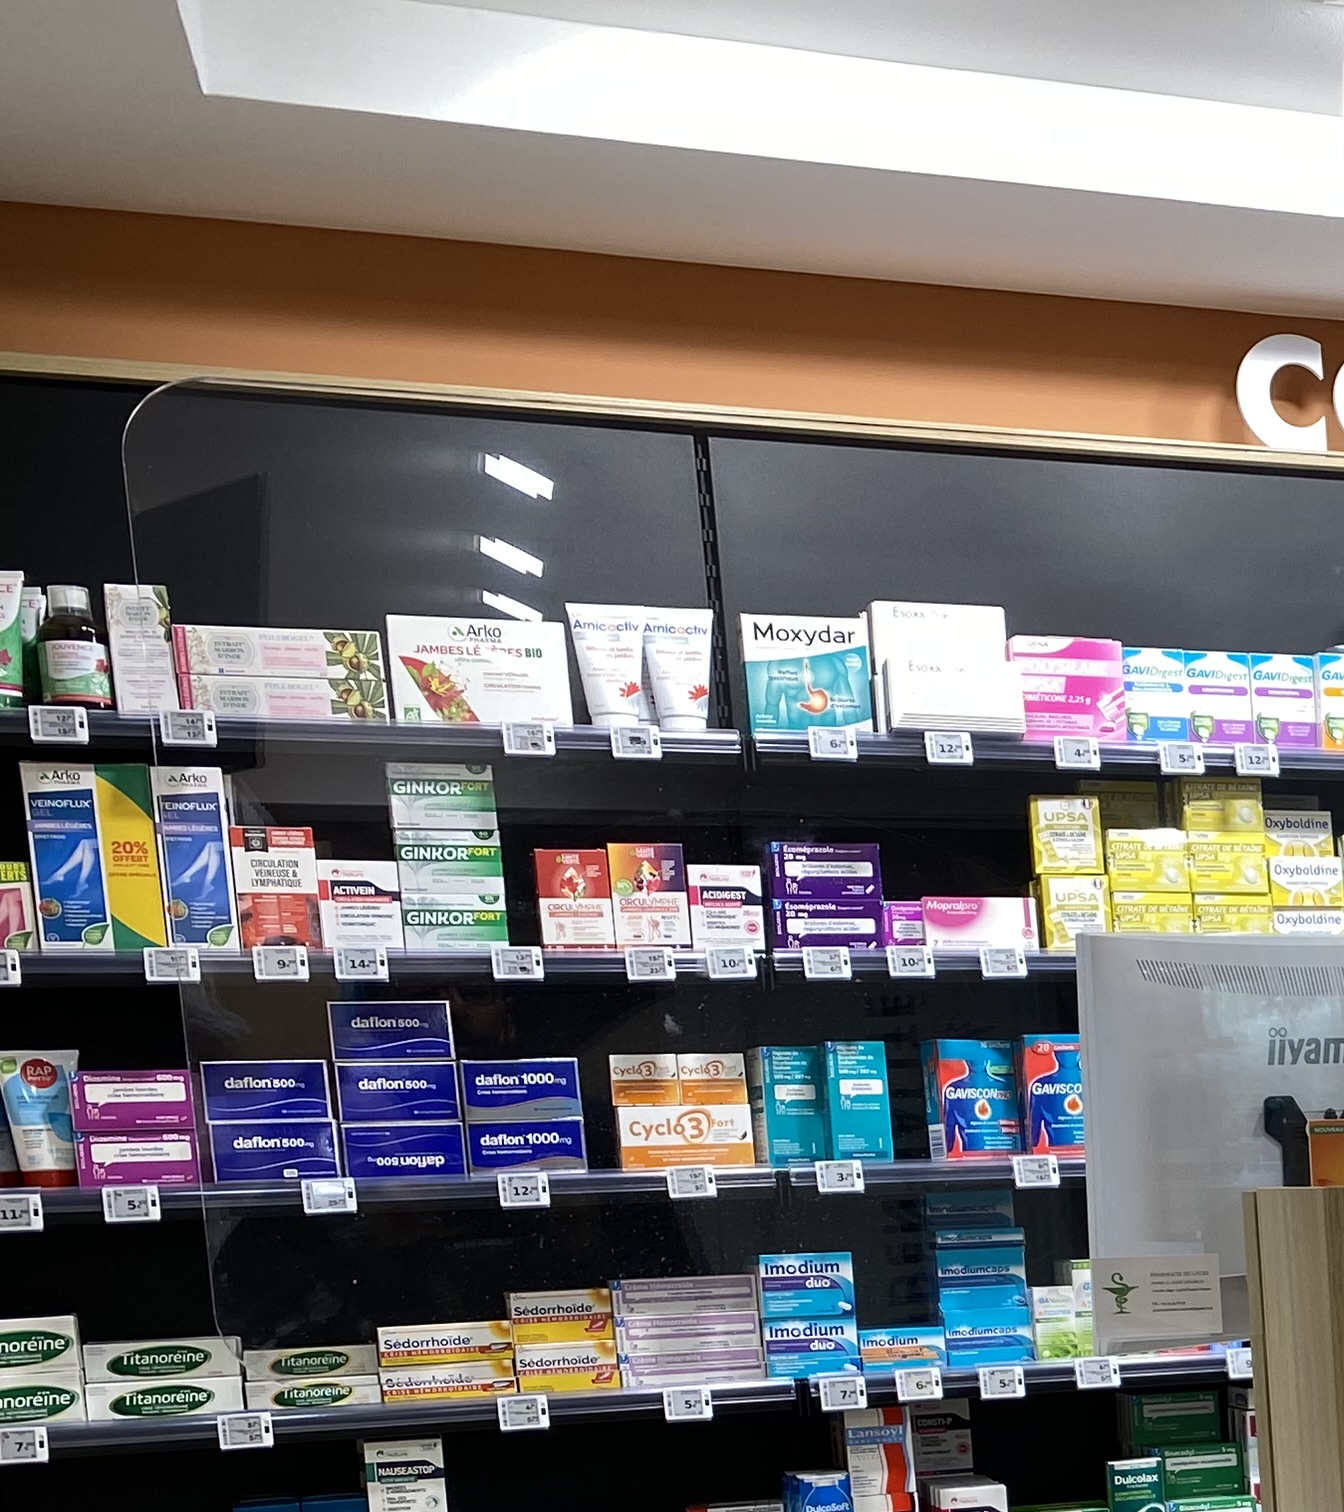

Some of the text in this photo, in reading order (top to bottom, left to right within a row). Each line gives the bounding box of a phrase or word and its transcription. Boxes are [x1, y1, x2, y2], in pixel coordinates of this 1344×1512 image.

[466, 625, 501, 638] Arko
[753, 621, 856, 646] Moxydar
[414, 645, 542, 658] JAMBES BIO
[31, 799, 91, 811] VEINOFLUX
[1044, 811, 1088, 823] UPSA
[1264, 817, 1329, 831] Oxyboldine
[111, 840, 149, 855] 20%
[113, 853, 149, 864] OFFERT
[250, 859, 299, 871] CIRCULATION
[252, 869, 290, 880] VEINEUSE
[1274, 863, 1339, 878] Oxyboldine
[251, 877, 302, 889] LYMPHATIQUE
[332, 885, 376, 896] ACTIVEIN
[702, 890, 746, 900] ACIDIGEST
[1055, 890, 1098, 902] UPSA
[927, 899, 979, 912] Mopralpro
[351, 1016, 397, 1030] daflon
[26, 1064, 52, 1077] RAP
[612, 1065, 642, 1079] Cyclo
[475, 1072, 520, 1088] daflon
[946, 1086, 998, 1100] GAVISCON
[628, 1116, 735, 1140] Cyclo 3 Fort
[763, 1259, 841, 1276] Imodium
[939, 1263, 1011, 1278] Imodiumcaps
[805, 1275, 831, 1290] duo
[768, 1322, 845, 1339] Imodium
[378, 1465, 436, 1478] NAUSEASTOP
